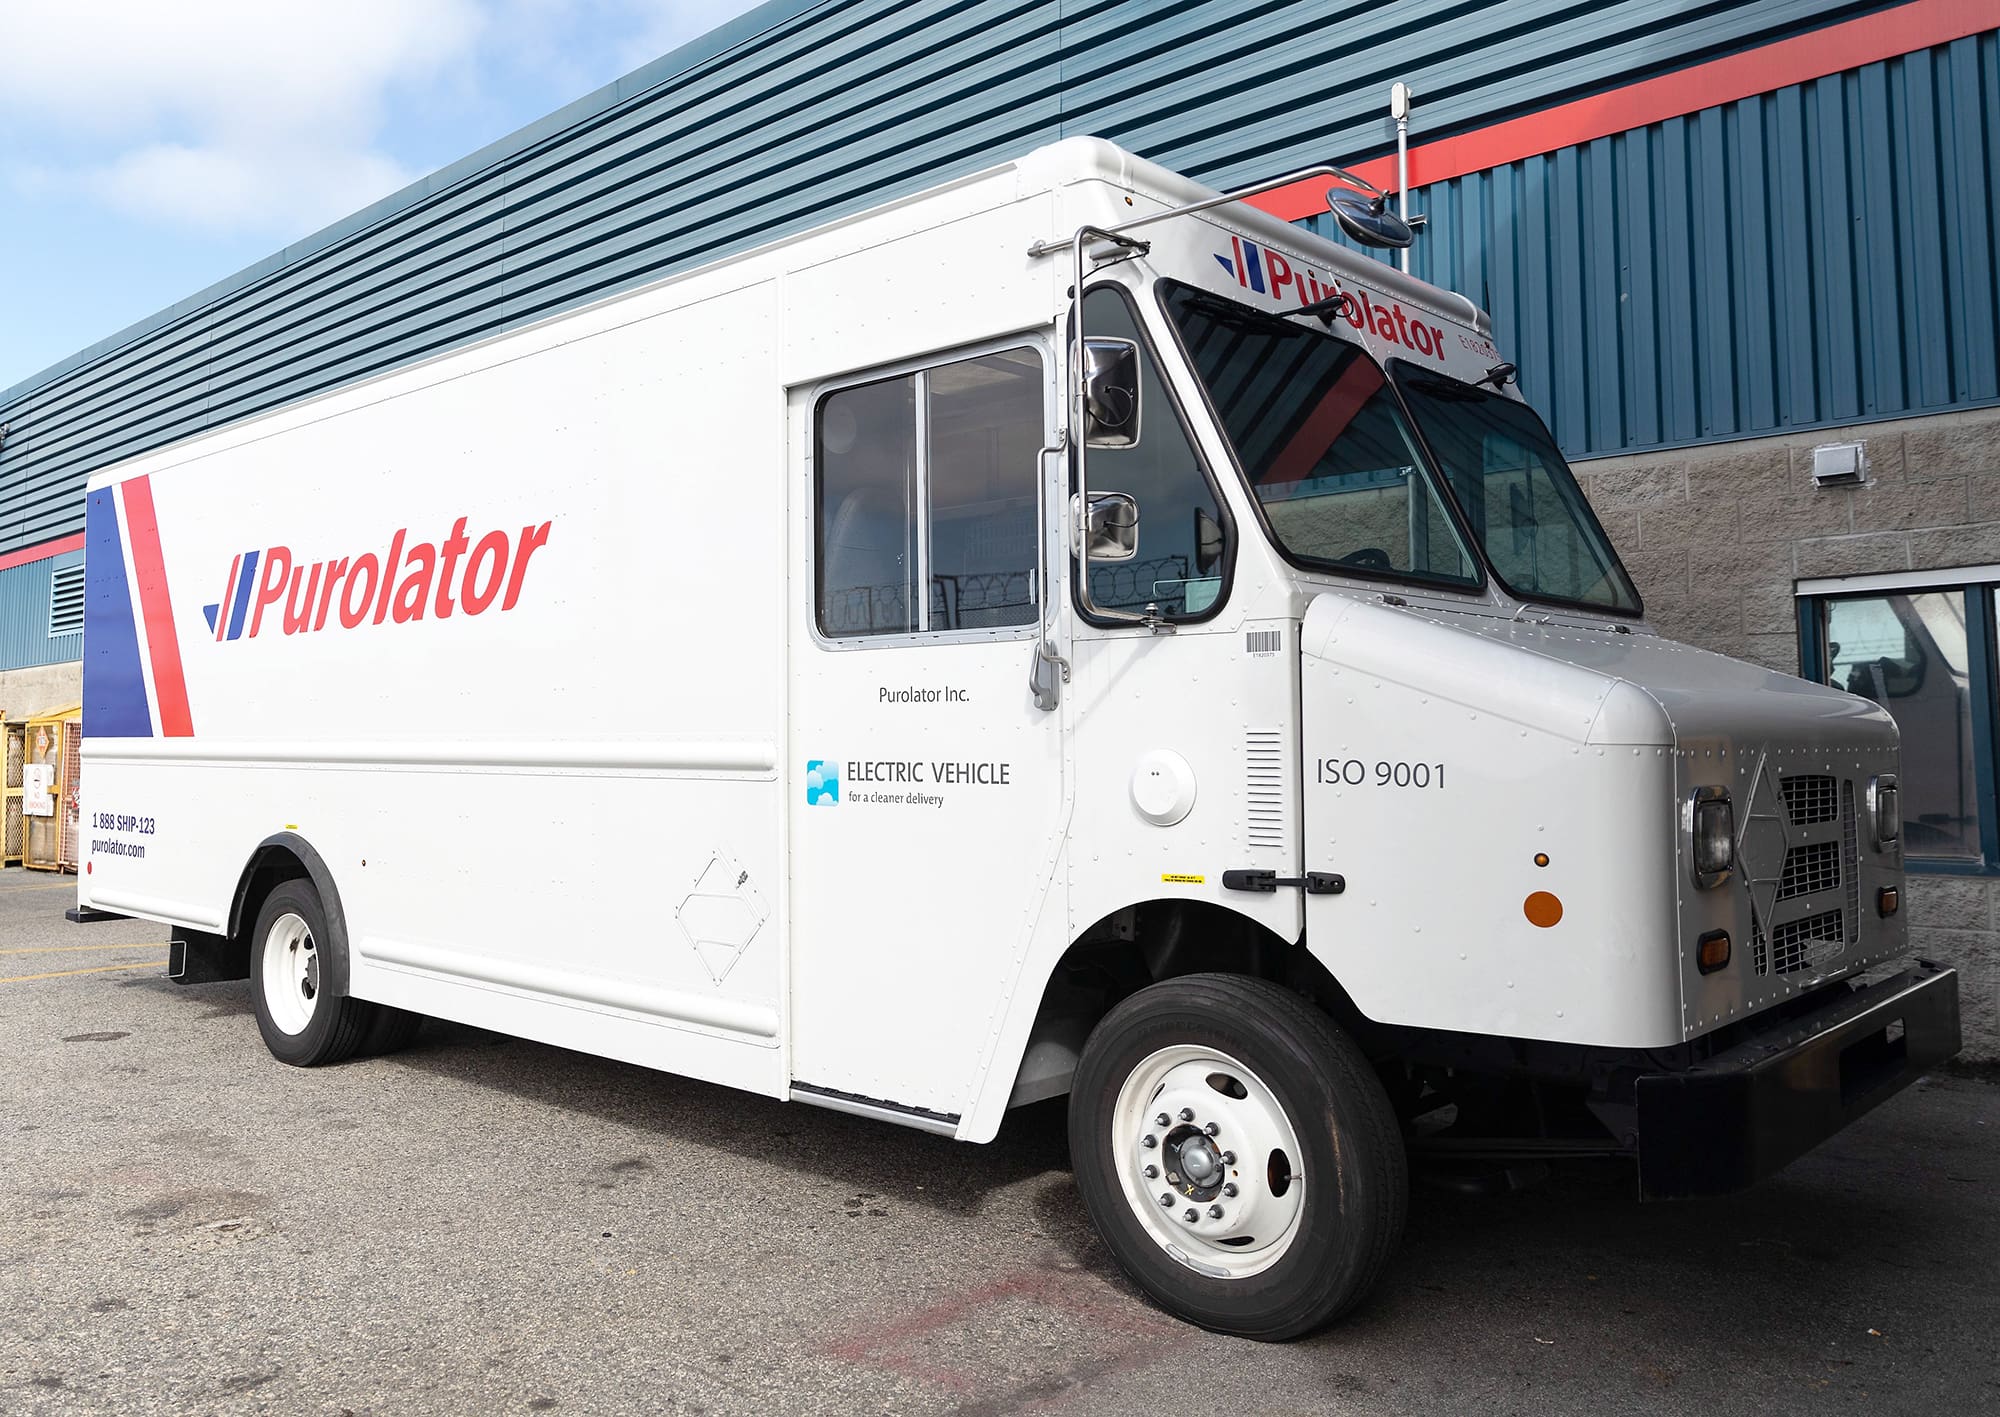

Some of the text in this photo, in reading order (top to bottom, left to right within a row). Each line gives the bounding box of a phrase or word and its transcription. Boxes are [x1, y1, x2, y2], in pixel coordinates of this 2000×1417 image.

[249, 516, 552, 638] Purolator
[879, 686, 970, 703] Purolator Inc.
[847, 761, 1010, 785] ELECTRIC VEHICLE
[1317, 758, 1444, 789] ISO 9001
[848, 791, 944, 808] for a cleaner delivery
[92, 812, 155, 835] 1 888 SHIP-123
[91, 837, 145, 859] purolator.com
